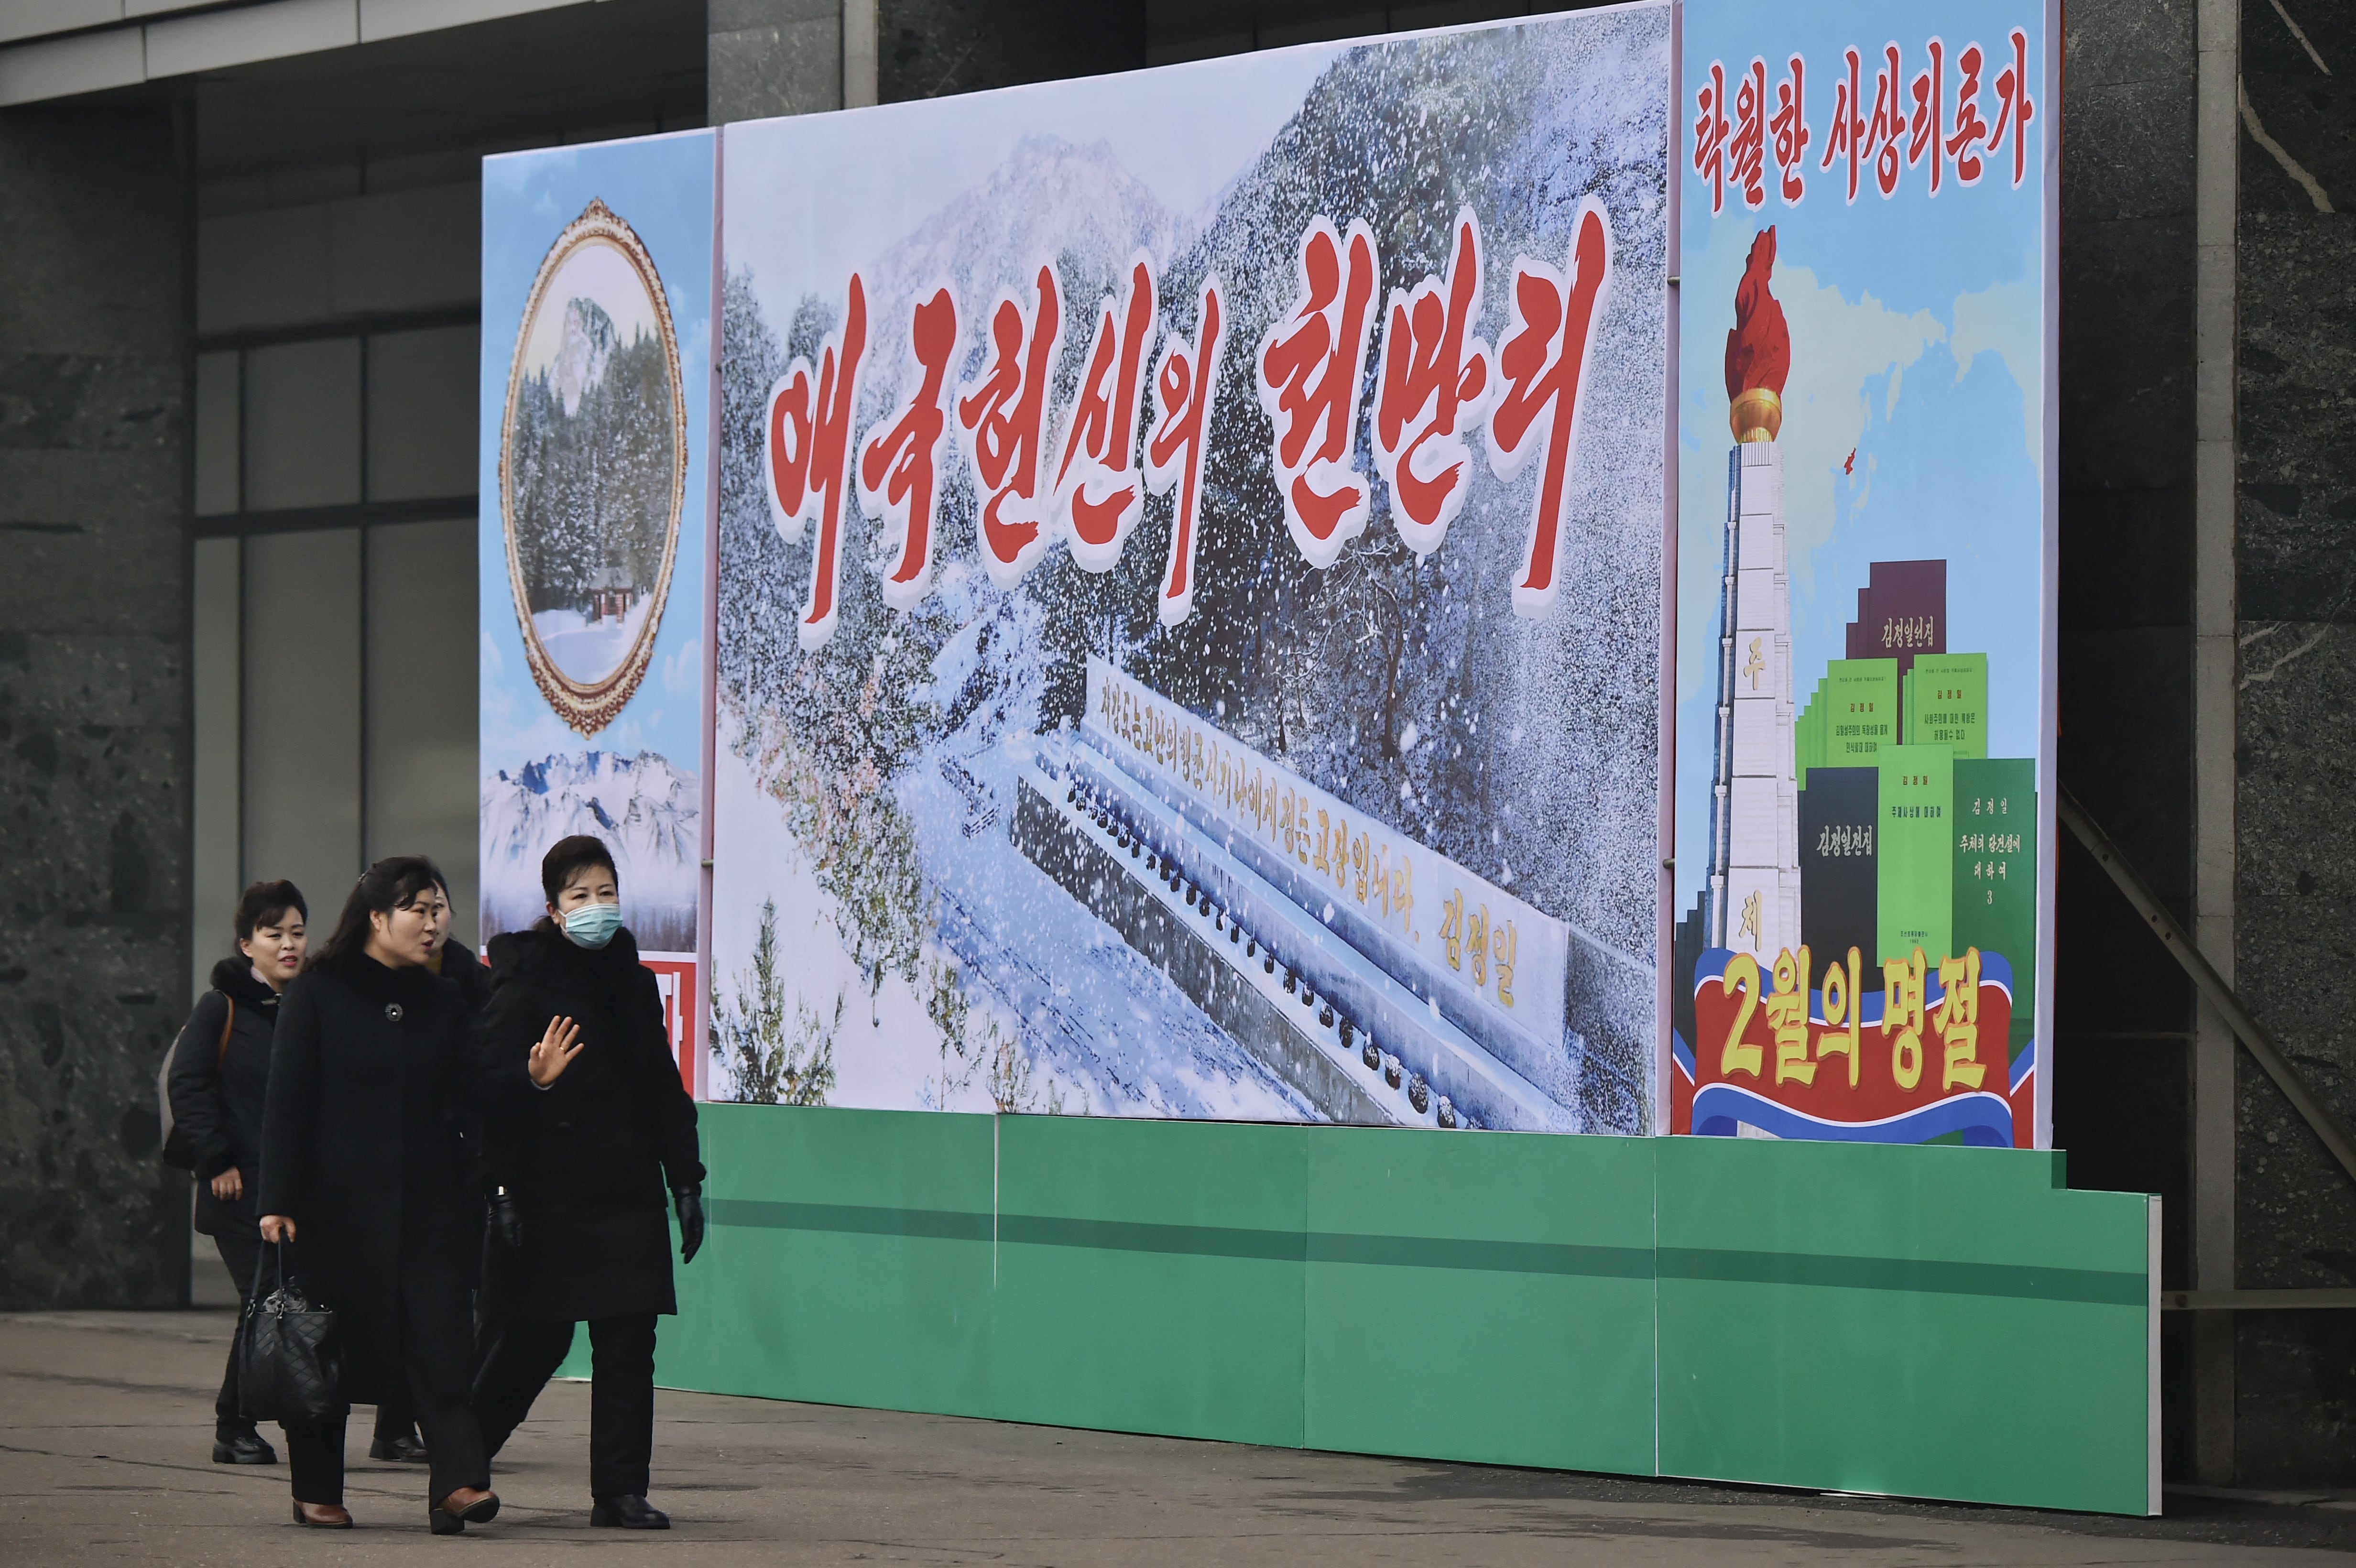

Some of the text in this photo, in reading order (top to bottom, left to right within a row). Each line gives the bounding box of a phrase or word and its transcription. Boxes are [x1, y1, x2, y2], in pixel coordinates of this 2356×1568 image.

[1695, 31, 2032, 212] 탁월한 사상리론가
[771, 210, 1605, 624] 애국헌신의 천만리
[1881, 615, 1934, 648] 김정일선집
[1938, 690, 1961, 699] 김정일
[1851, 703, 1873, 712] 김정일
[1865, 741, 1877, 753] 대하여
[1903, 775, 1928, 785] 김정일
[1972, 798, 2007, 815] 김정일
[1816, 825, 1873, 857] 김정일전집
[1960, 834, 2020, 853] 주체의 당건설에
[1974, 861, 2007, 880] 대하여
[1279, 787, 1311, 865] 정든
[1439, 888, 1517, 1008] 김정일
[1987, 890, 1993, 904] 3
[1721, 944, 1987, 1093] 2월의 명절
